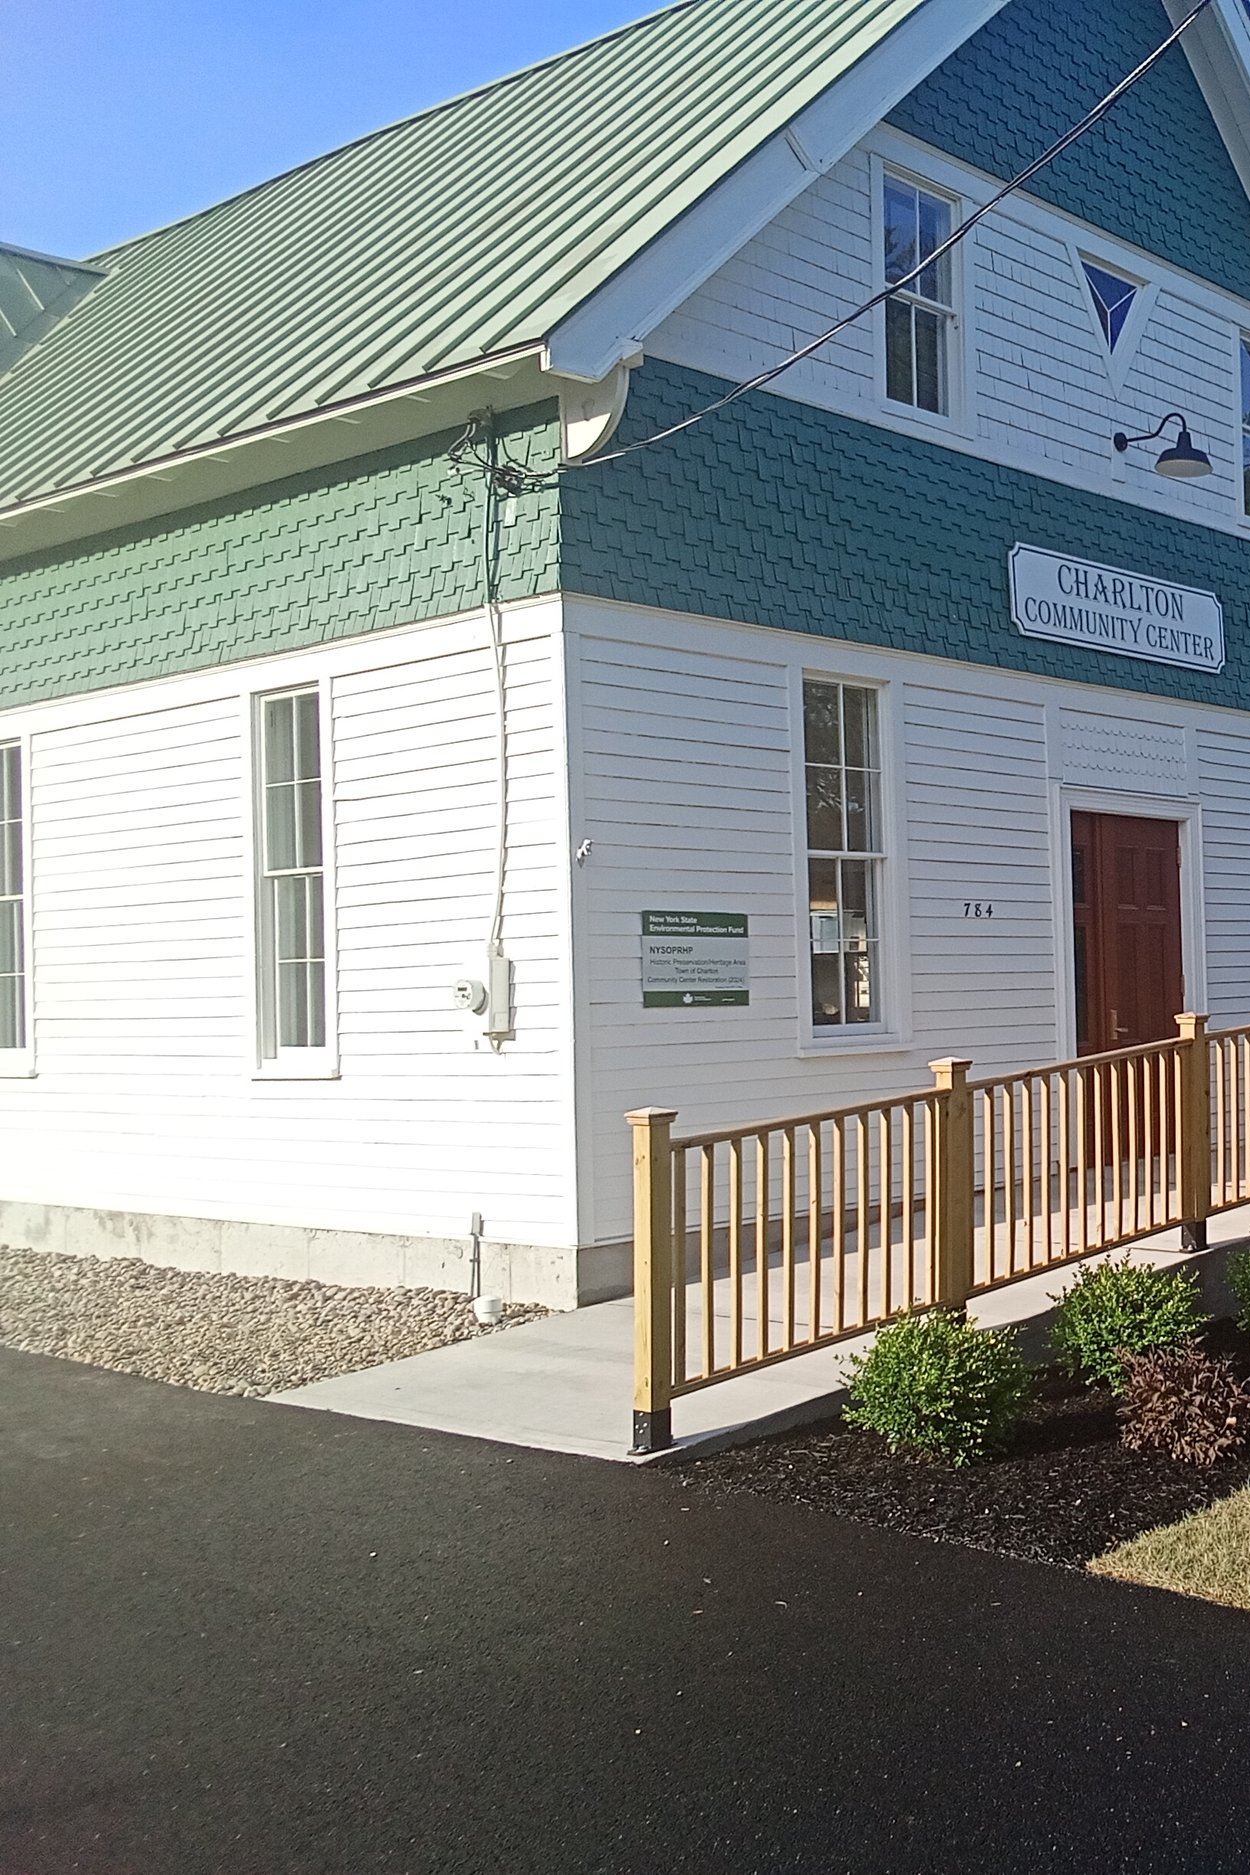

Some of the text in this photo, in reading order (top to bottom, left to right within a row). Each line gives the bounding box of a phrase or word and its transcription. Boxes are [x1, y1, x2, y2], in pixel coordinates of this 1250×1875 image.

[1057, 564, 1184, 622] CHARLTON
[1024, 597, 1215, 661] COMMUNITY CENTER
[964, 903, 993, 918] 784
[649, 915, 698, 924] New York State
[649, 924, 744, 934] Environmental Protection Fund
[649, 946, 693, 954] NYSOPRHP
[647, 976, 677, 984] Community
